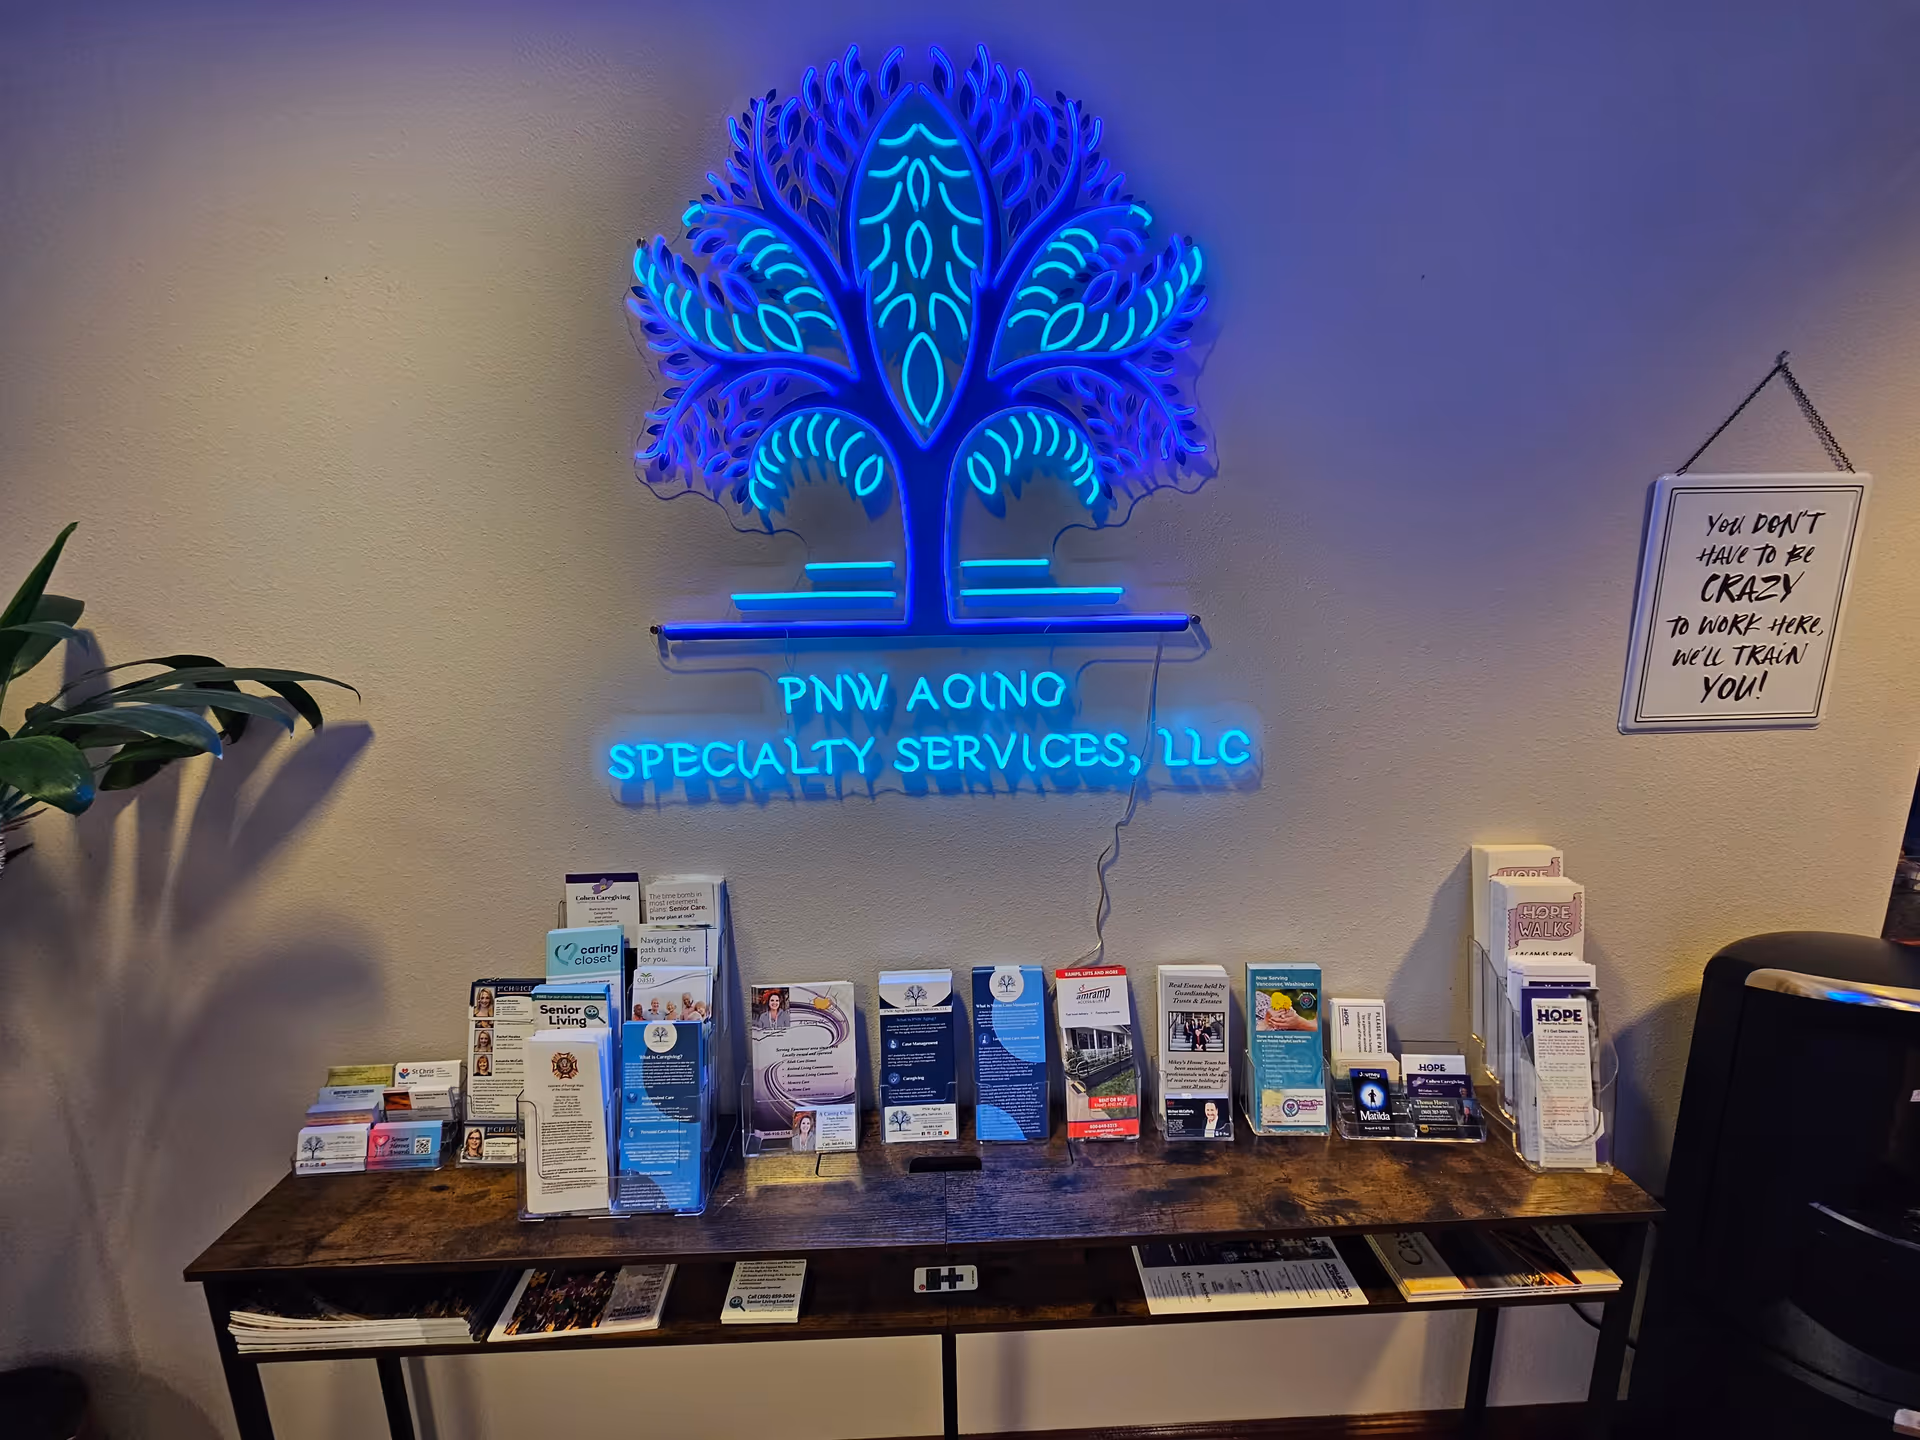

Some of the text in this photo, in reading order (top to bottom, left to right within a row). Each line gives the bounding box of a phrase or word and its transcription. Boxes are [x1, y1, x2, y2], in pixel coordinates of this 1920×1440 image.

[1751, 510, 1826, 538] DON'T
[1753, 543, 1777, 567] TO
[1701, 571, 1805, 604] CRAZY
[1666, 615, 1689, 638] TO
[1698, 613, 1762, 636] WORK
[777, 672, 888, 714] PNW
[1700, 670, 1768, 703] YOU!
[608, 727, 1251, 781] SPECIALTY SERVICES, LLC
[1521, 905, 1572, 919] HOPE
[1518, 922, 1572, 937] WALKS
[640, 937, 677, 945] Navigating
[580, 944, 618, 955] caring
[640, 946, 655, 954] path
[679, 945, 696, 954] right
[575, 954, 611, 965] closet
[1076, 988, 1111, 1000] amramp
[1174, 990, 1219, 998] Guardianships,
[540, 1005, 581, 1014] Senior
[1536, 1009, 1583, 1022] HOPE
[549, 1015, 587, 1028] Living
[1418, 1063, 1446, 1072] HOPE
[1360, 1110, 1390, 1121] Matilda
